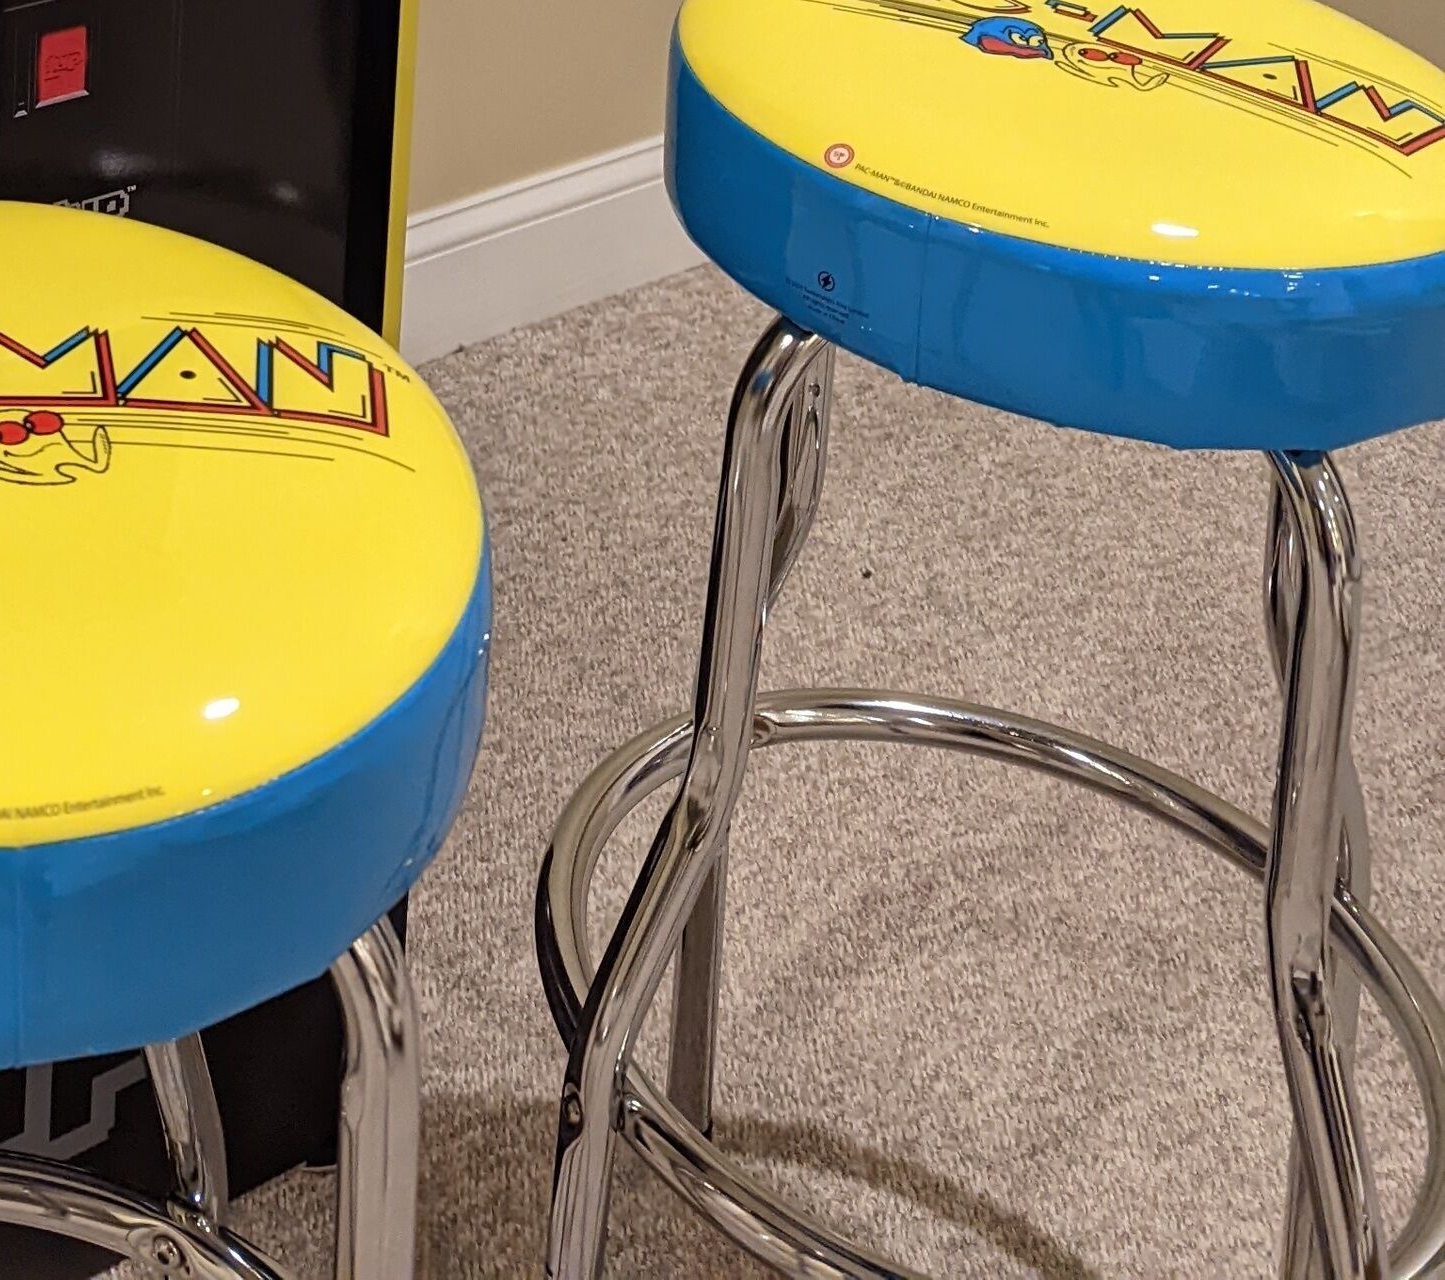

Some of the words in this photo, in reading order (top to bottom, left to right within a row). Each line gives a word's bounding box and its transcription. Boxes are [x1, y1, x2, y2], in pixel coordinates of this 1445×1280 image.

[937, 191, 971, 208] NAMCO
[971, 202, 1033, 225] Entertainment
[1034, 217, 1050, 228] Inc.
[13, 803, 60, 819] NAMCO
[62, 787, 143, 814] Entertainment
